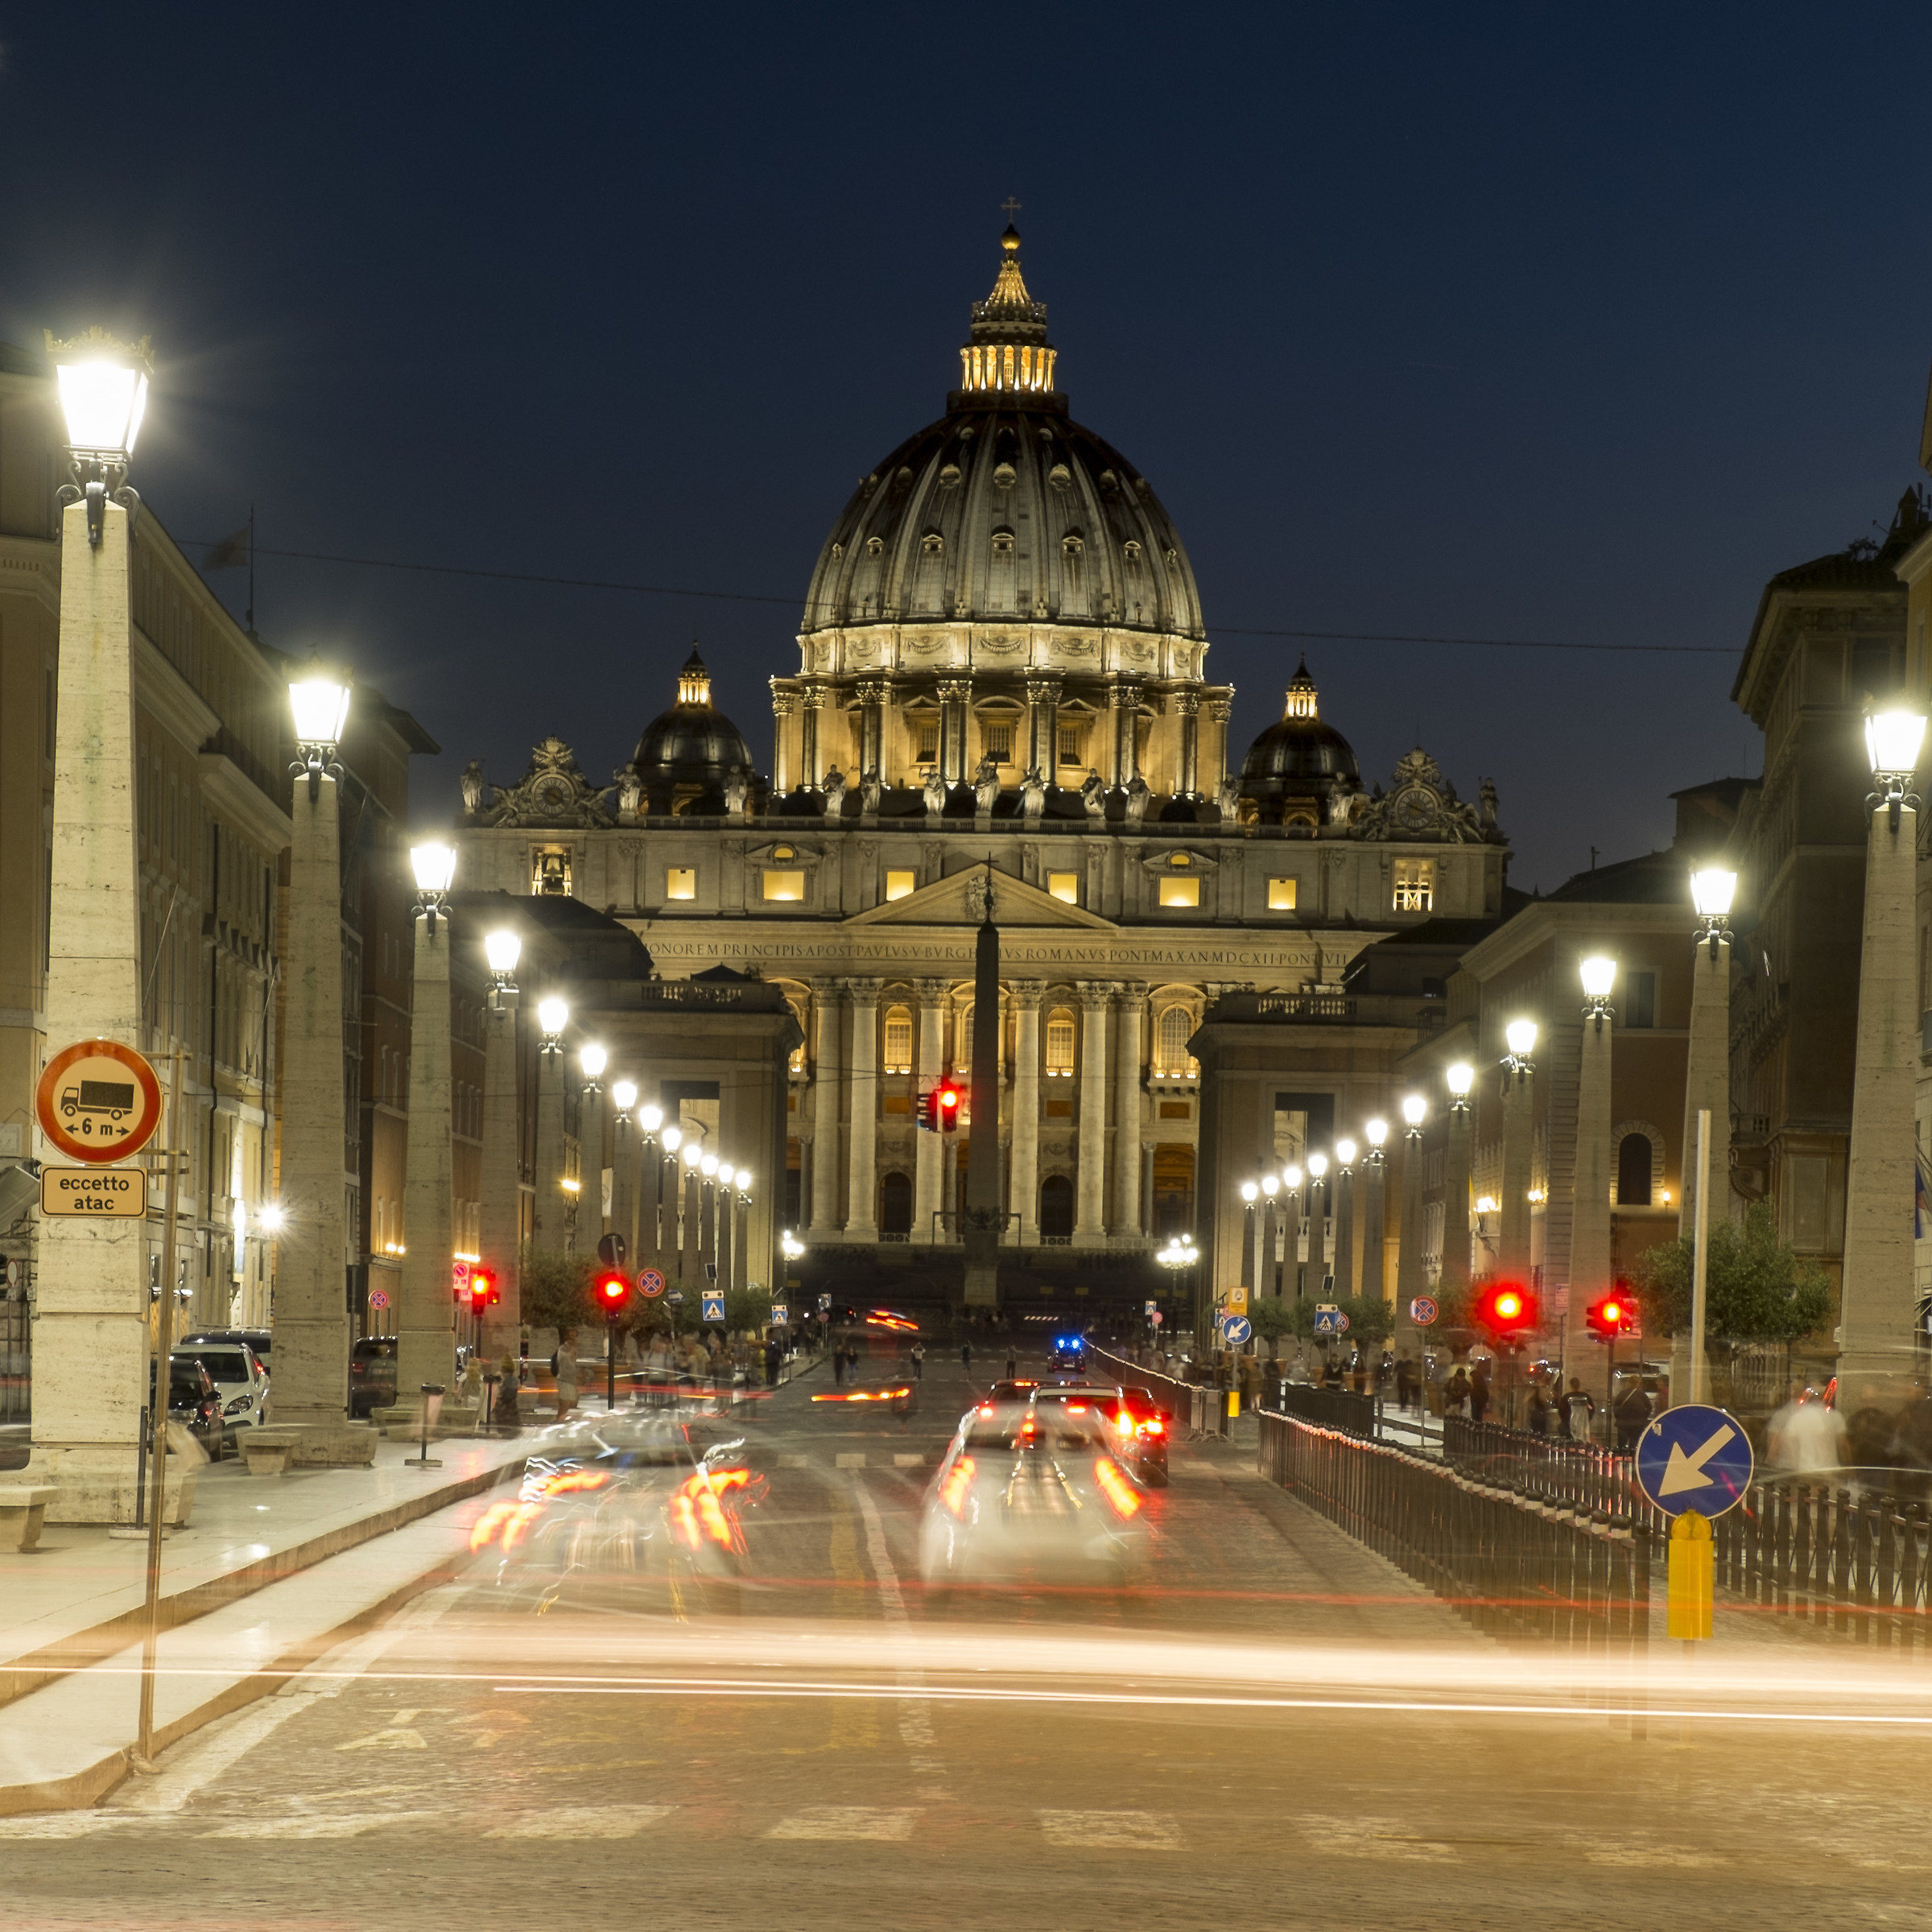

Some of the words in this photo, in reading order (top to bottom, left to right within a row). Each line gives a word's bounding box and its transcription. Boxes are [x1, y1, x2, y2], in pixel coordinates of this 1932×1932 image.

[645, 943, 719, 956] ONOREM
[724, 943, 803, 956] PRINCIPIS
[857, 946, 909, 958] PAVLVS
[1026, 948, 1105, 960] ROMANVS
[1110, 950, 1150, 962] PONT
[1151, 950, 1184, 963] MAX
[1212, 952, 1274, 964] MDCXII
[82, 1118, 92, 1135] 6
[100, 1125, 114, 1136] m
[60, 1176, 130, 1191] eccetto
[74, 1195, 114, 1210] atac
